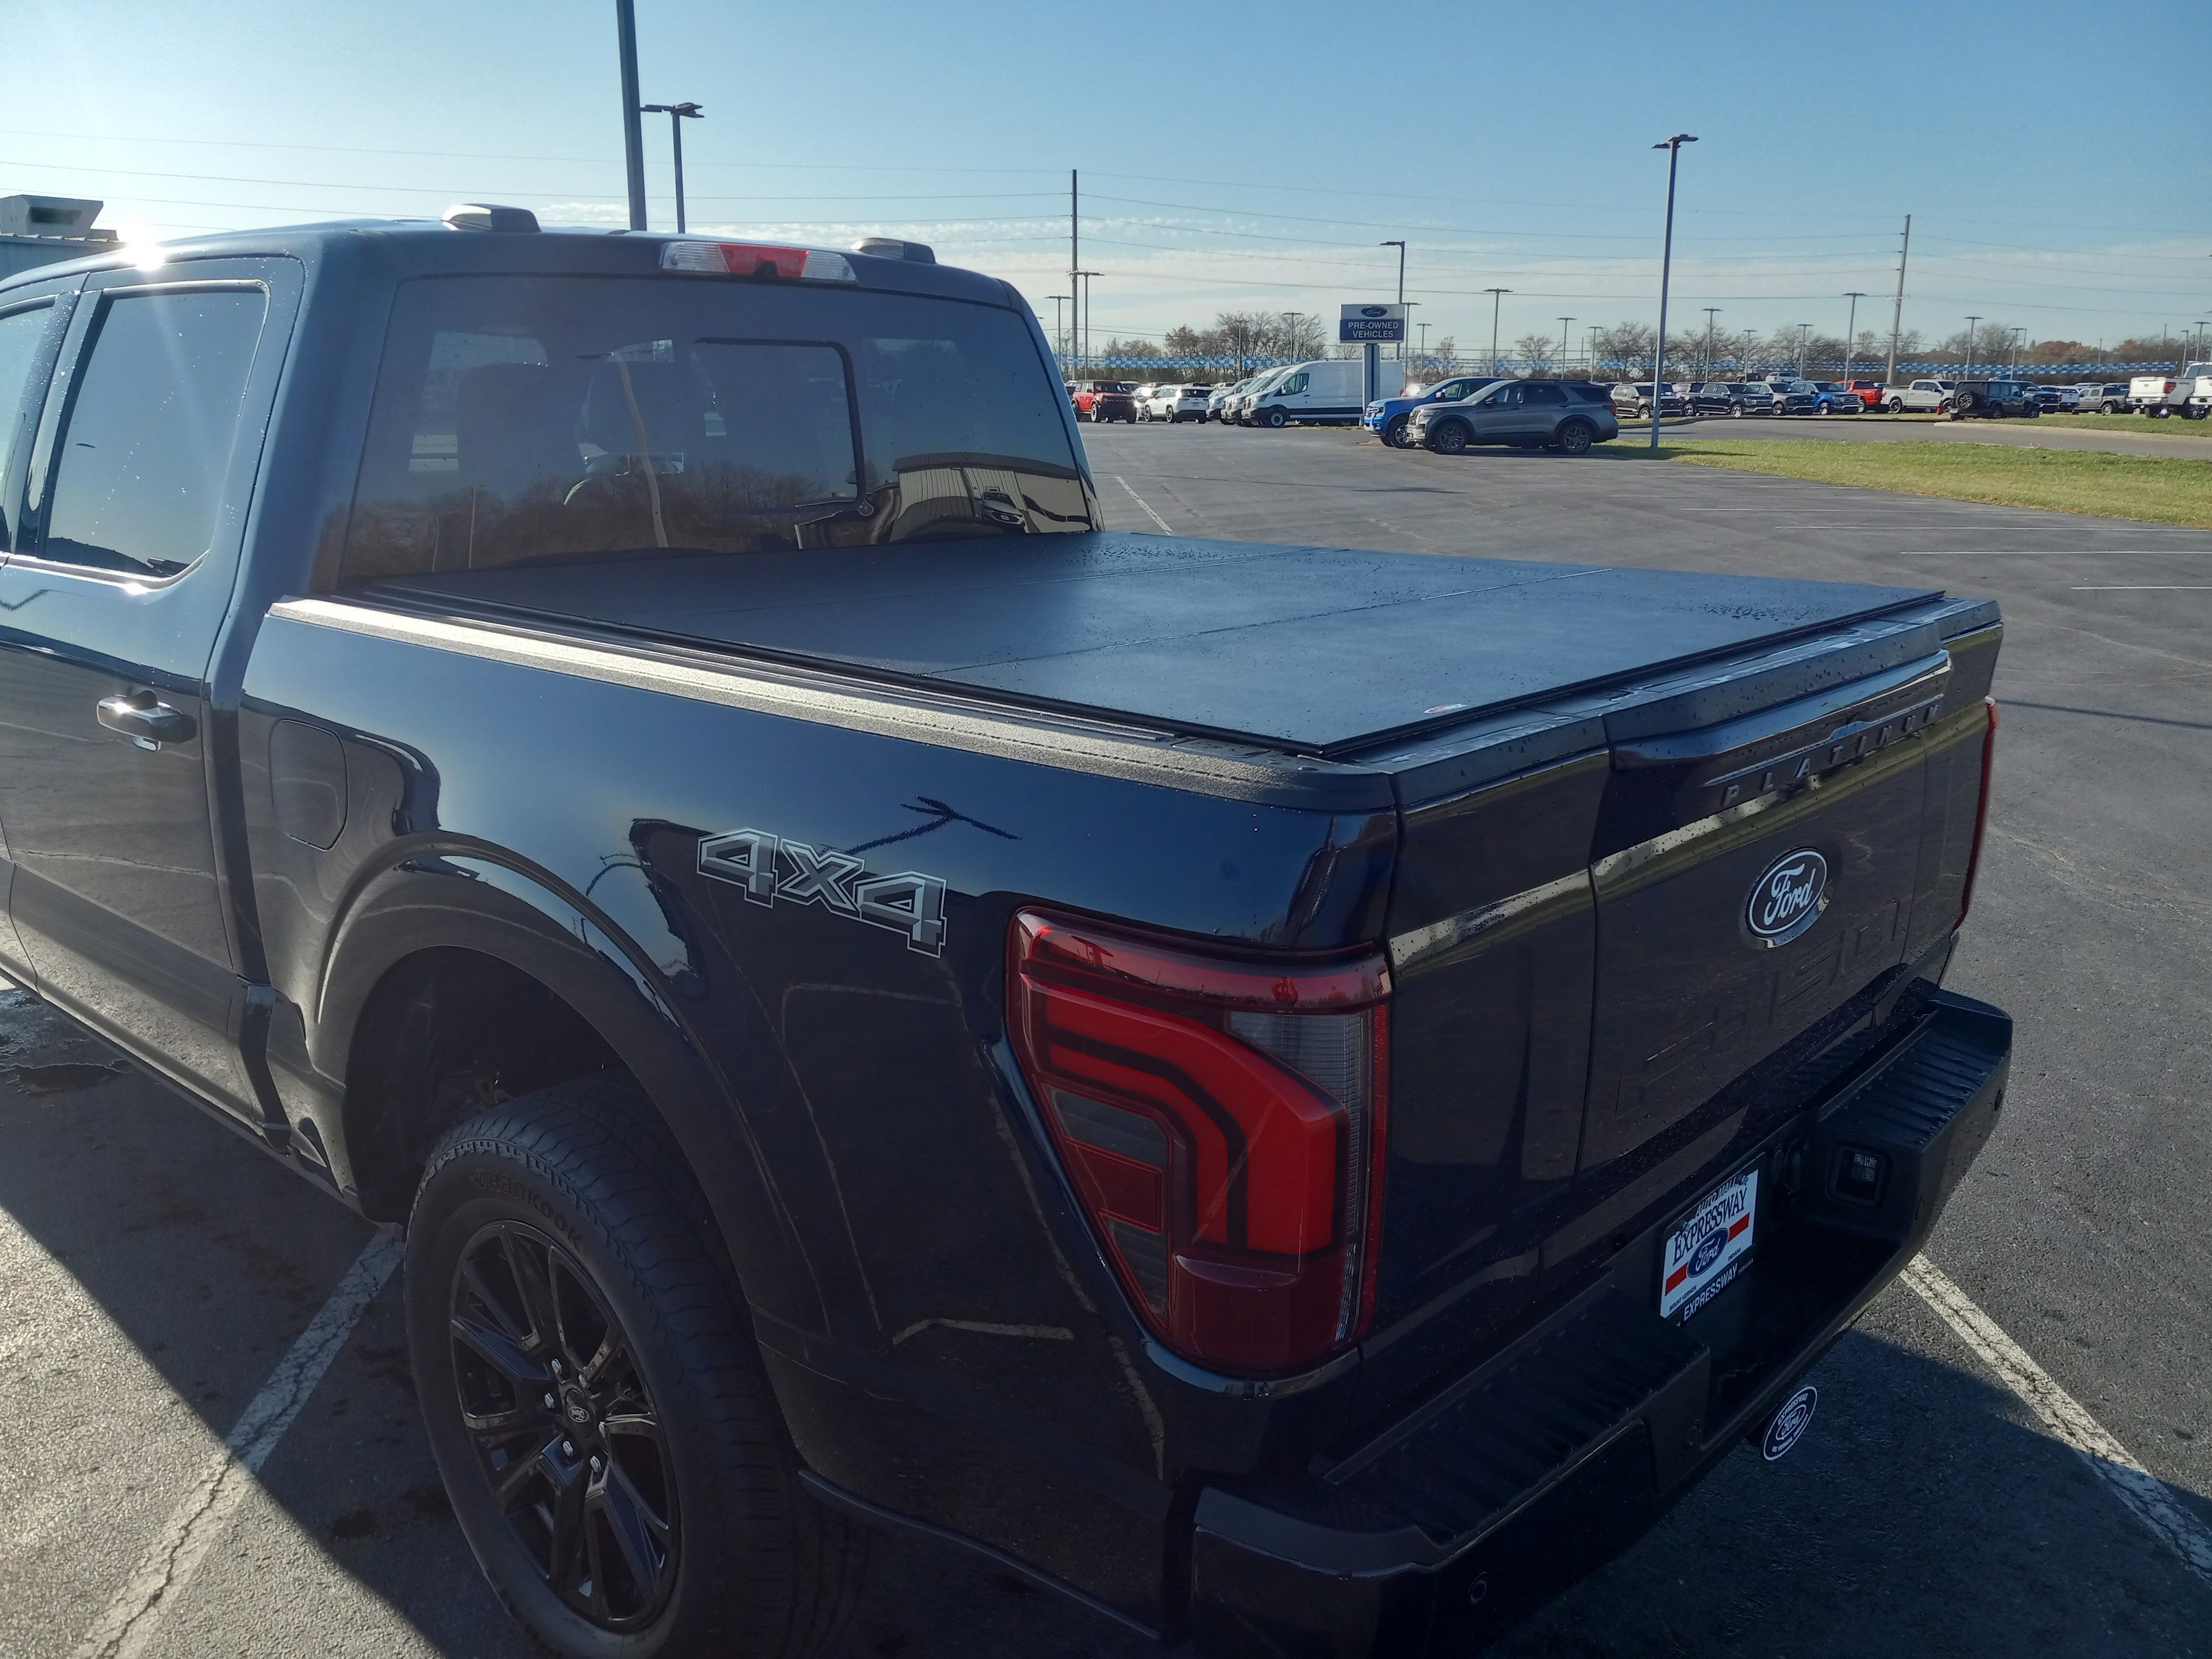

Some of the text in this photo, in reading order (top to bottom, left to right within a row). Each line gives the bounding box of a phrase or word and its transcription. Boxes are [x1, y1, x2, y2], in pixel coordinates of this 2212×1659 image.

[1348, 321, 1399, 329] PRE-OWNED
[1722, 703, 1940, 806] PLATINUM
[1764, 863, 1816, 926] Ford
[1672, 1187, 1747, 1267] EXPRESSWAY
[1695, 1191, 1717, 1218] AUTO
[1695, 1237, 1721, 1272] Ford
[1684, 1262, 1738, 1322] EXPRESSWAY
